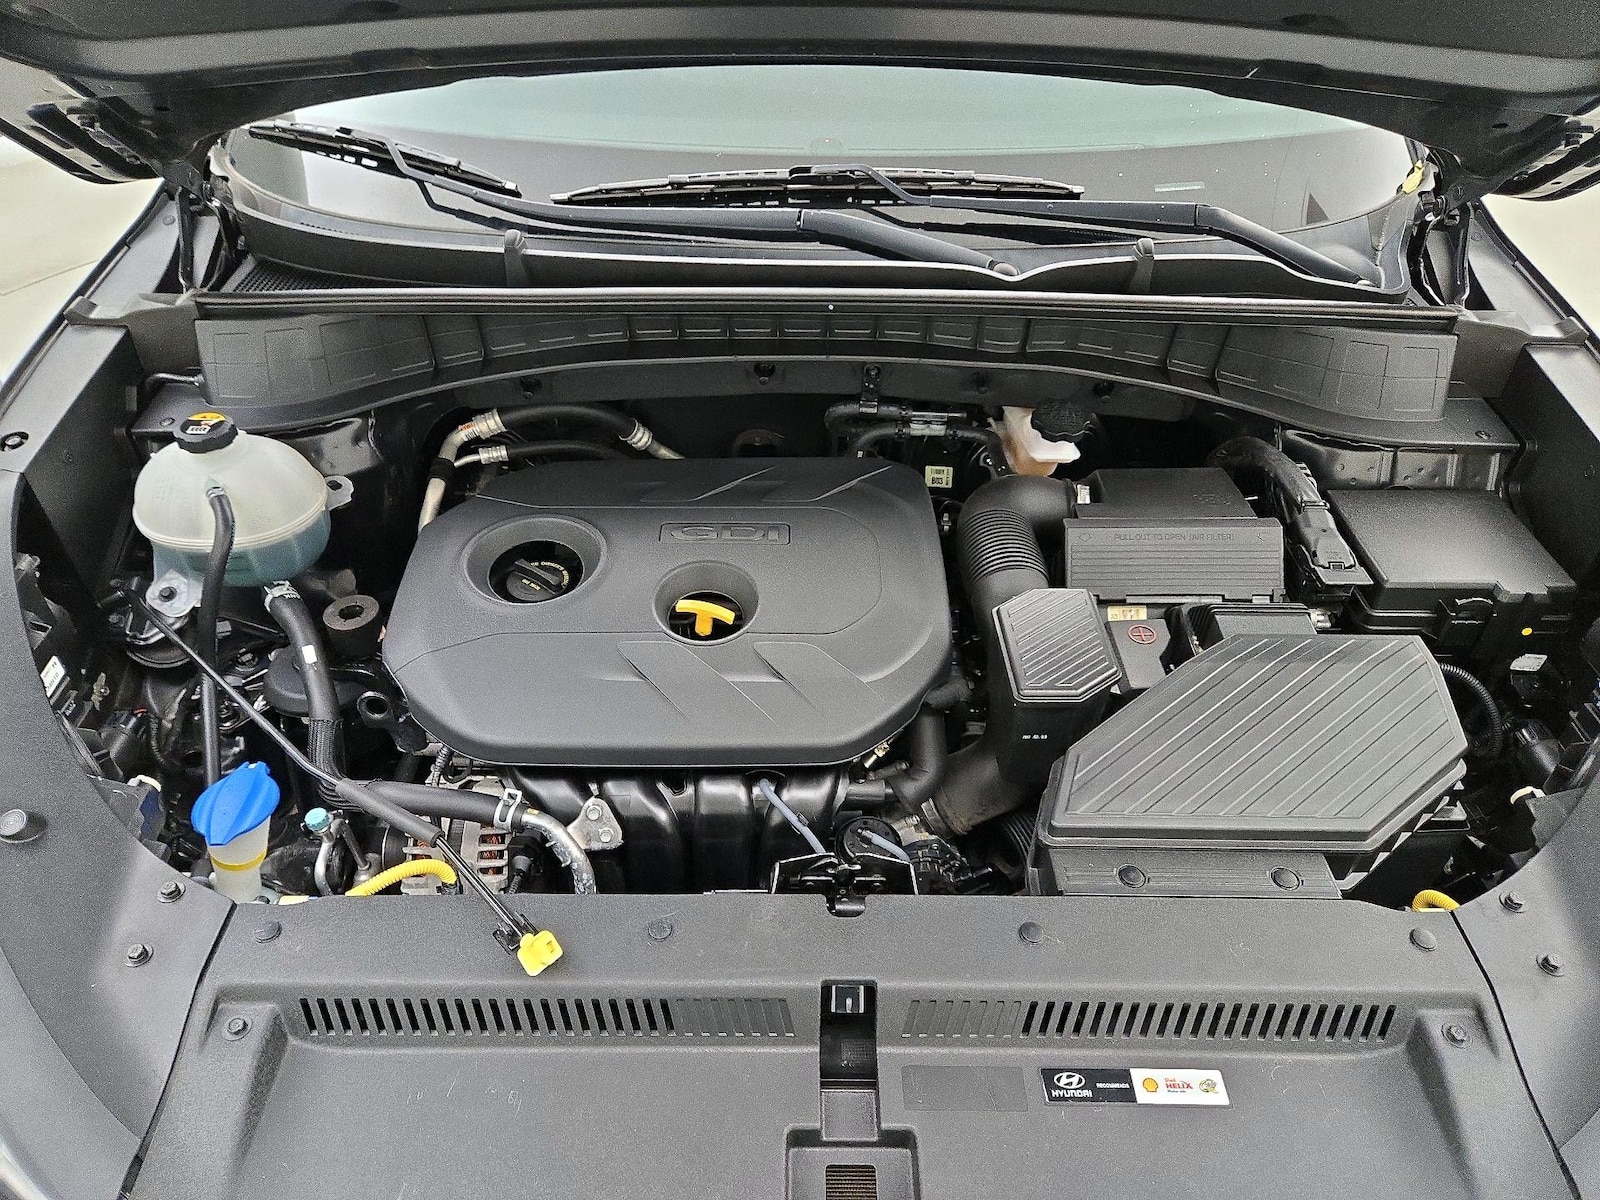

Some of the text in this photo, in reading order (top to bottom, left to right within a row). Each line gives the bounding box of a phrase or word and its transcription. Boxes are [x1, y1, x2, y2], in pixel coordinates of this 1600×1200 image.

[670, 525, 779, 541] GDI
[1165, 1082, 1194, 1090] HELIX
[1051, 1089, 1093, 1098] HYUNDAI
